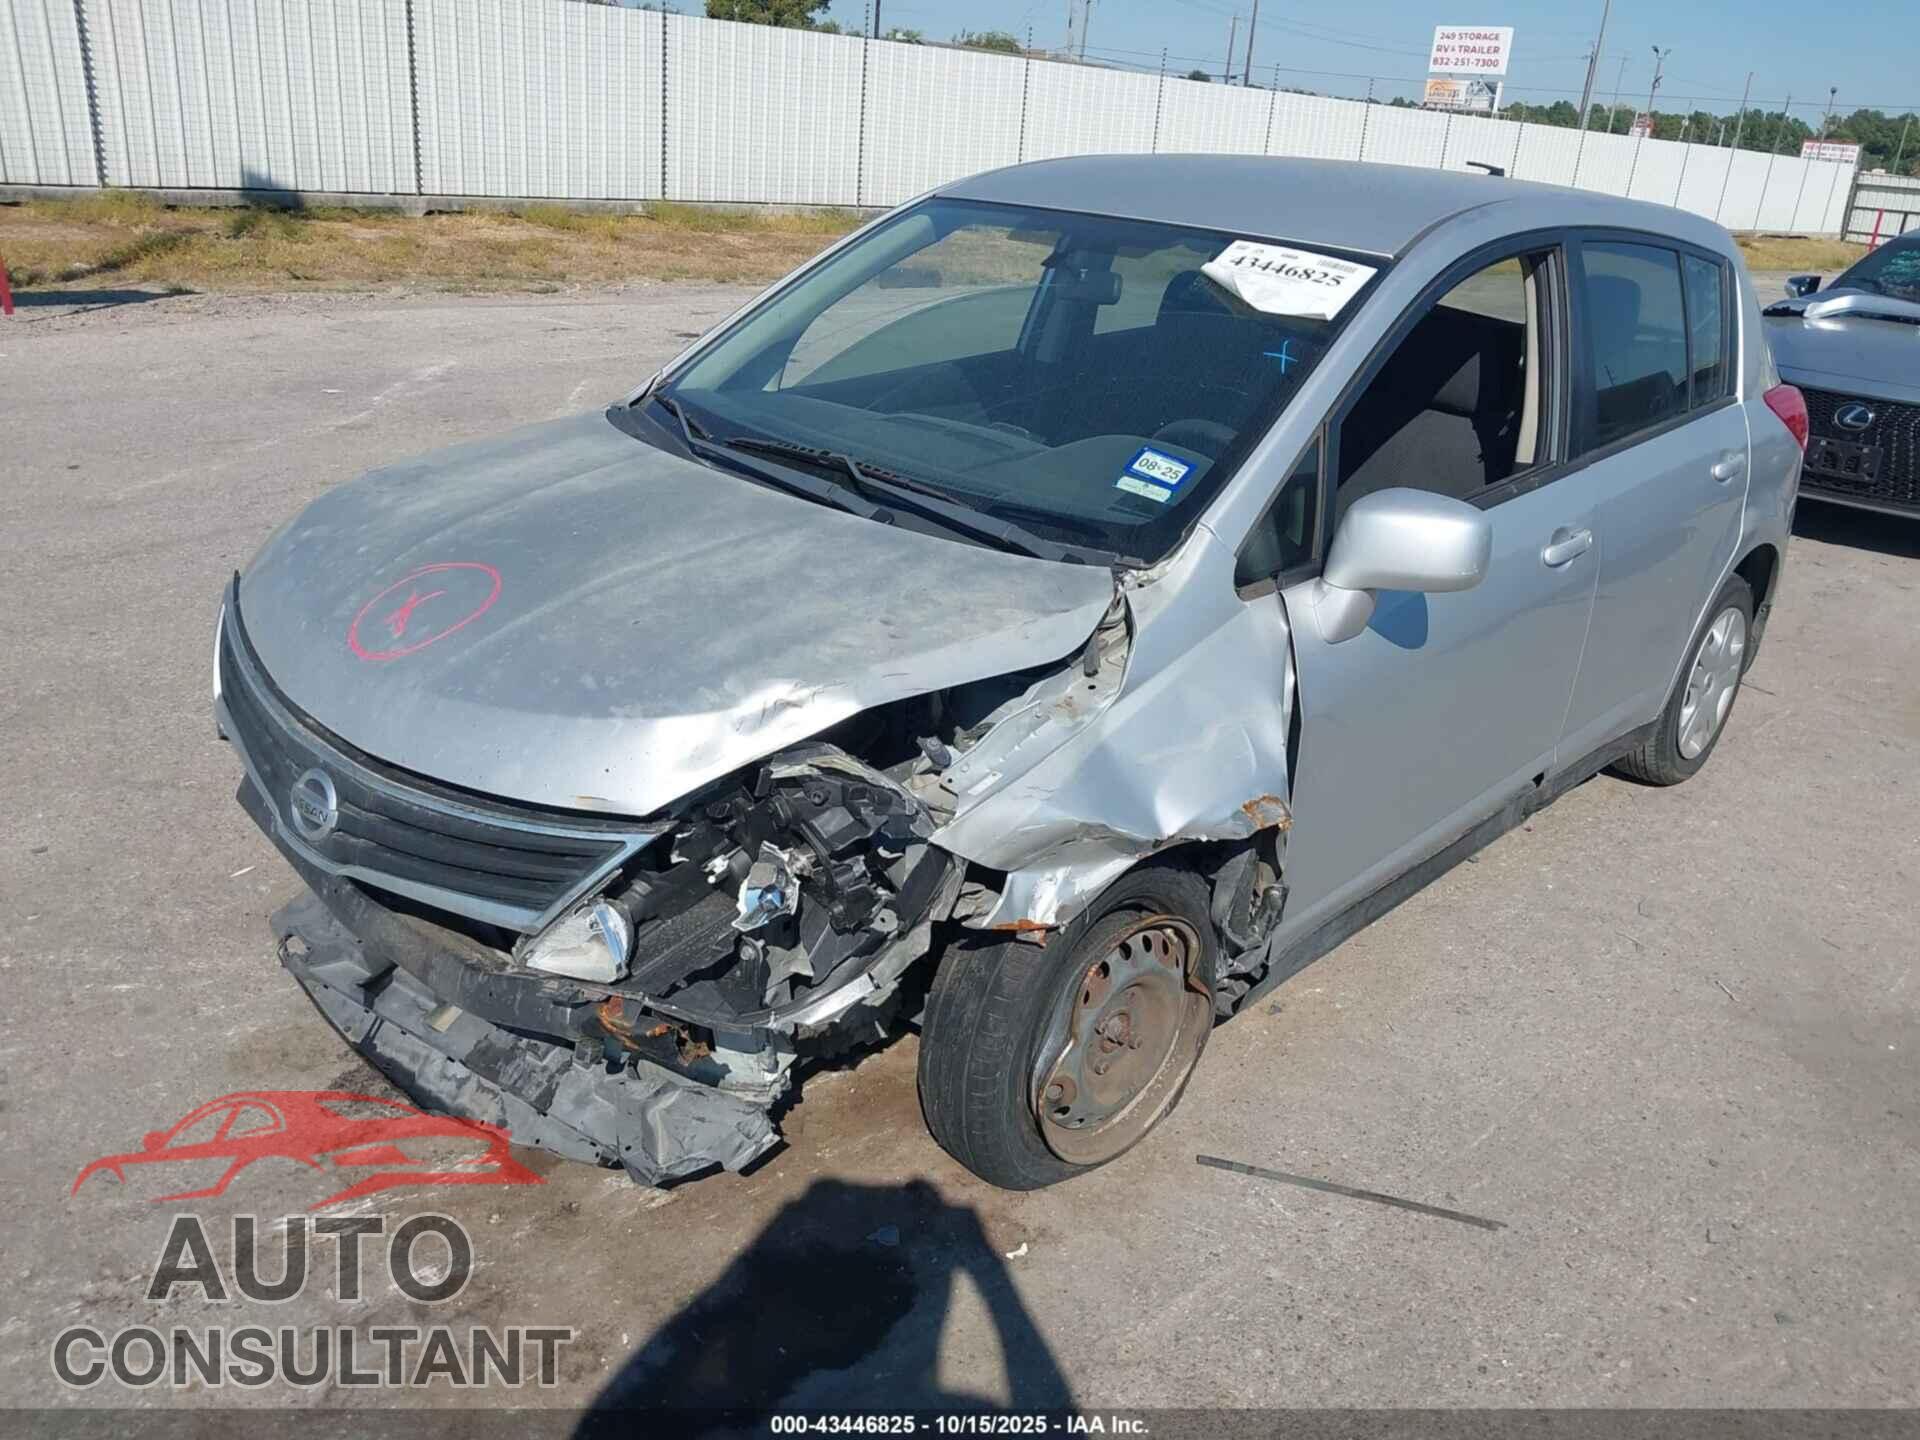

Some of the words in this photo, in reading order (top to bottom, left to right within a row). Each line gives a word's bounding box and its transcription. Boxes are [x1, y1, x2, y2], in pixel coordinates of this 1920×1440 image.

[1440, 32, 1456, 40] 249
[1458, 32, 1500, 41] STORAGE
[1436, 44, 1450, 53] RV
[1458, 45, 1500, 54] TRAILER
[1229, 254, 1345, 287] 43446825
